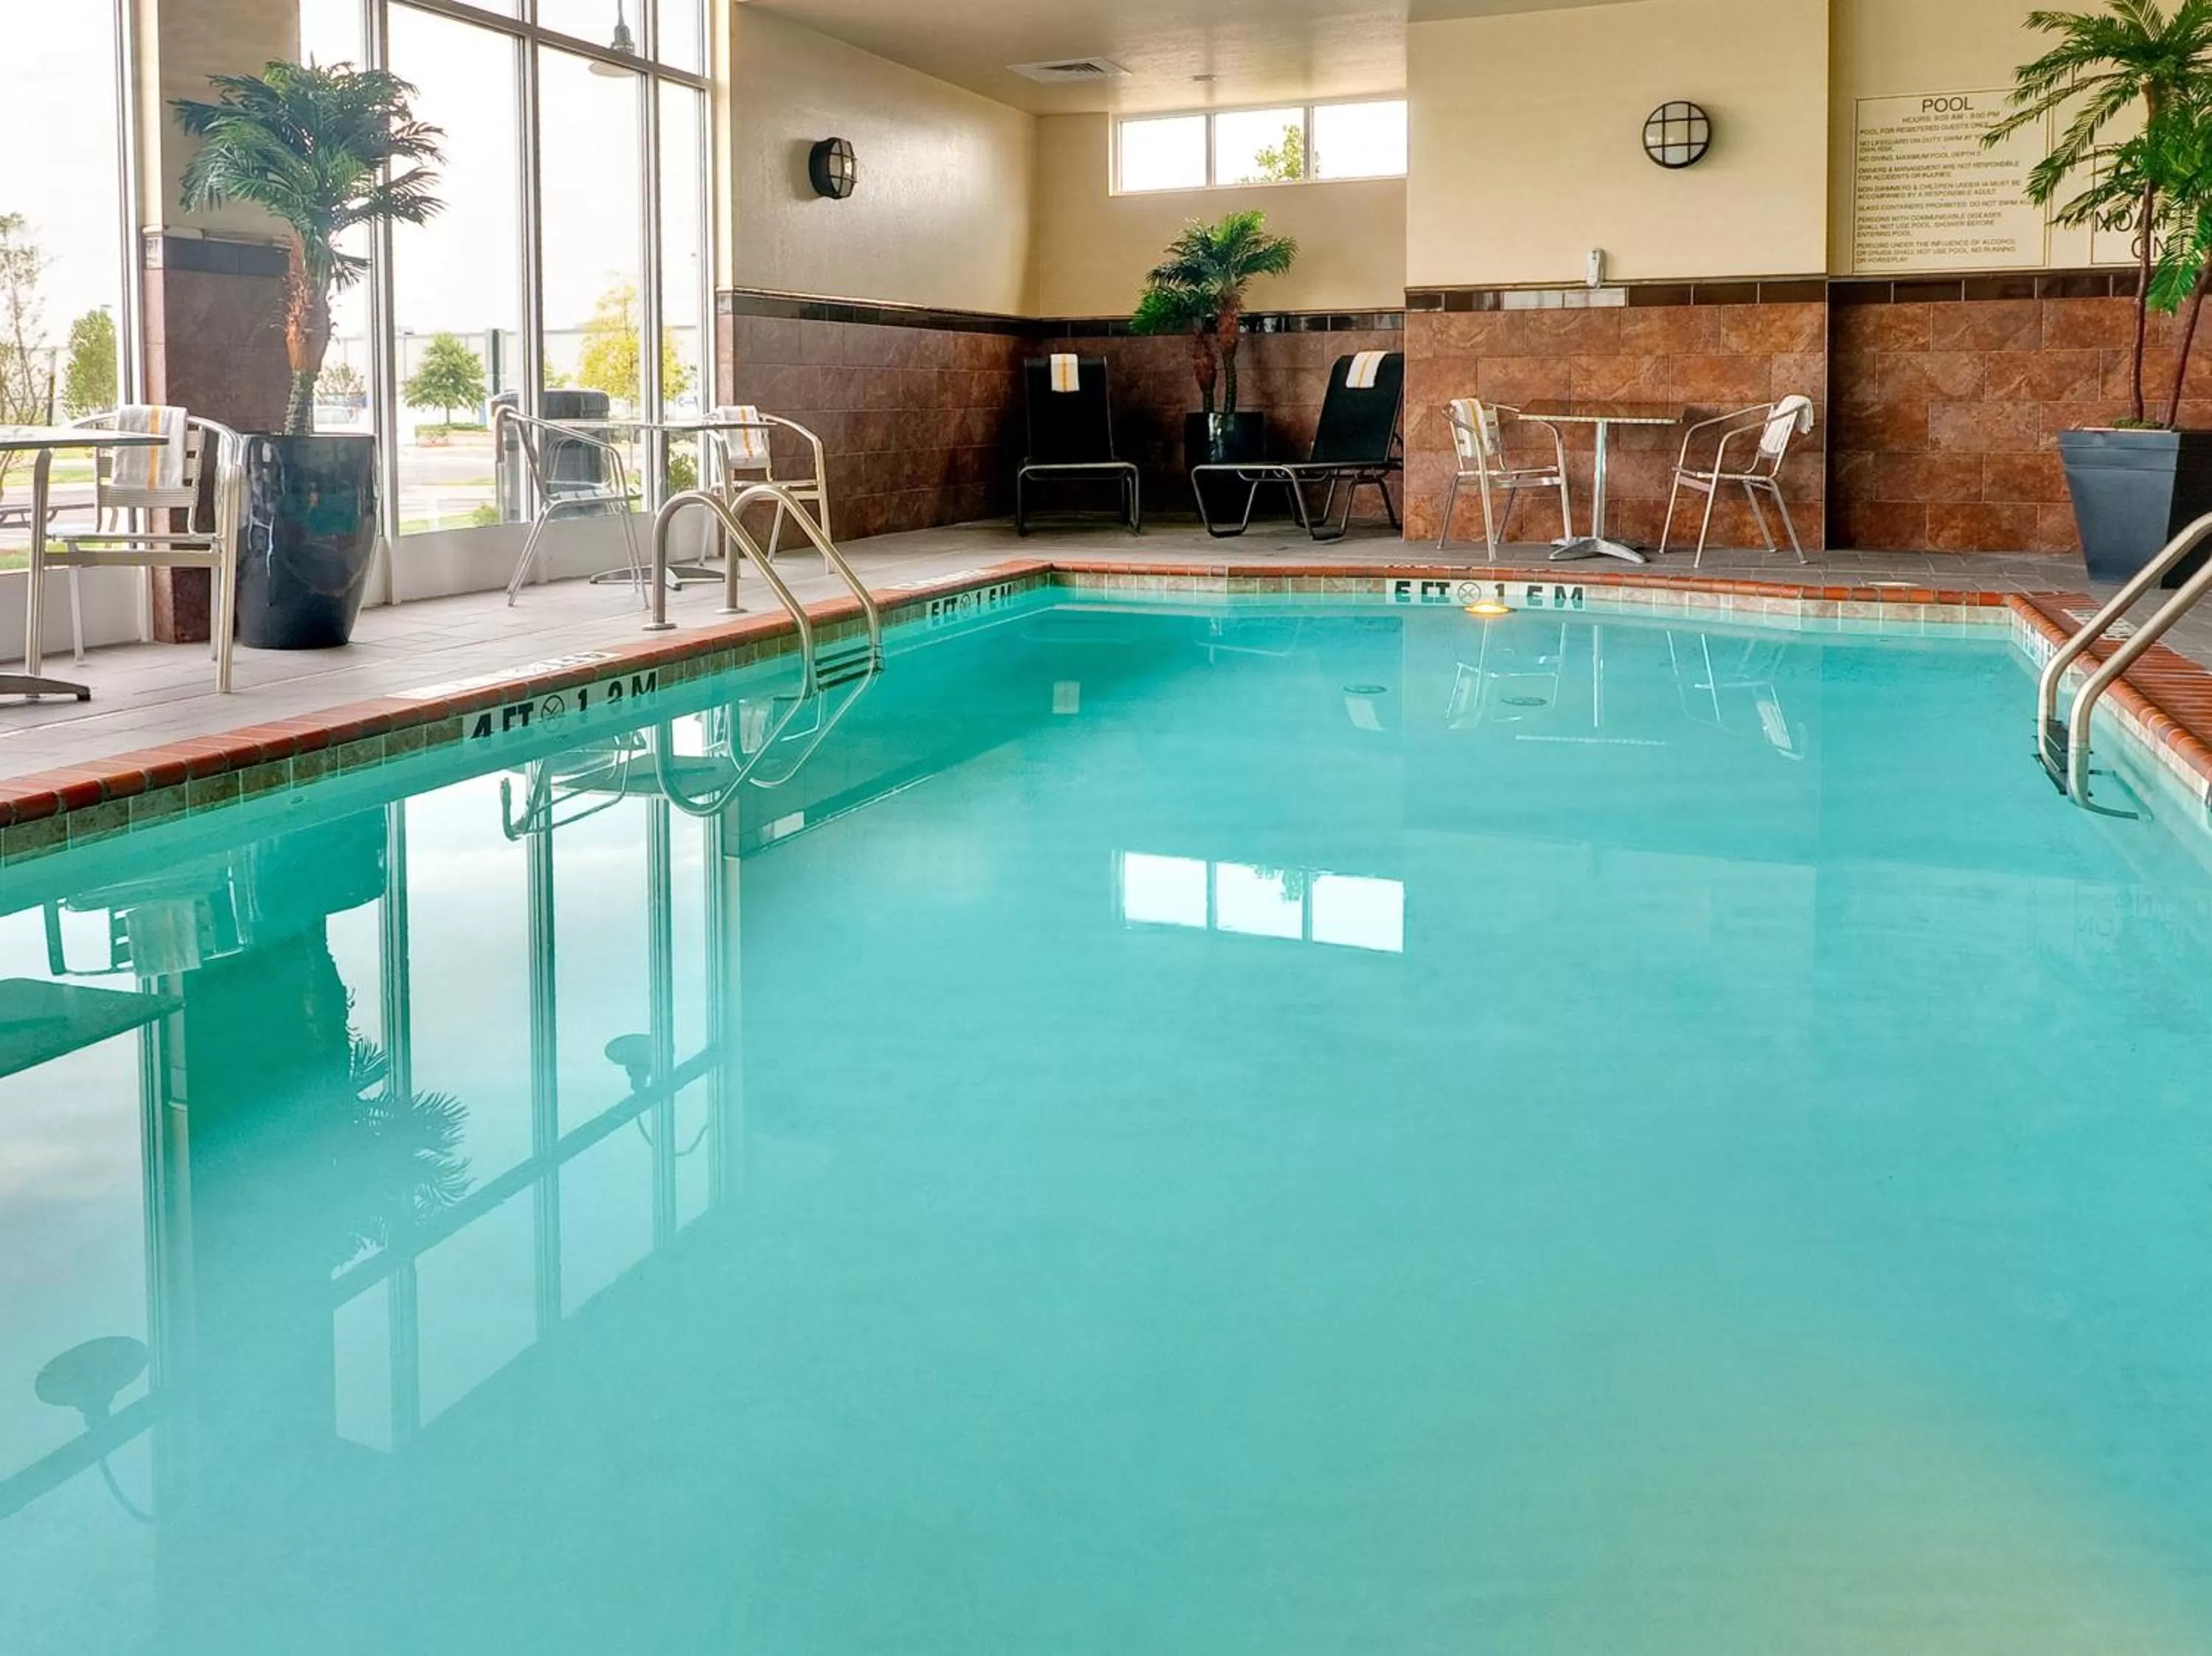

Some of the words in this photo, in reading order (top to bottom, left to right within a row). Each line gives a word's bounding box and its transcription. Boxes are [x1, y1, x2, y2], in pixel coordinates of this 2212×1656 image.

[1921, 97, 1974, 113] POOL
[1972, 160, 2019, 168] RESPONSIBLE
[1919, 182, 1954, 190] CHILDREN
